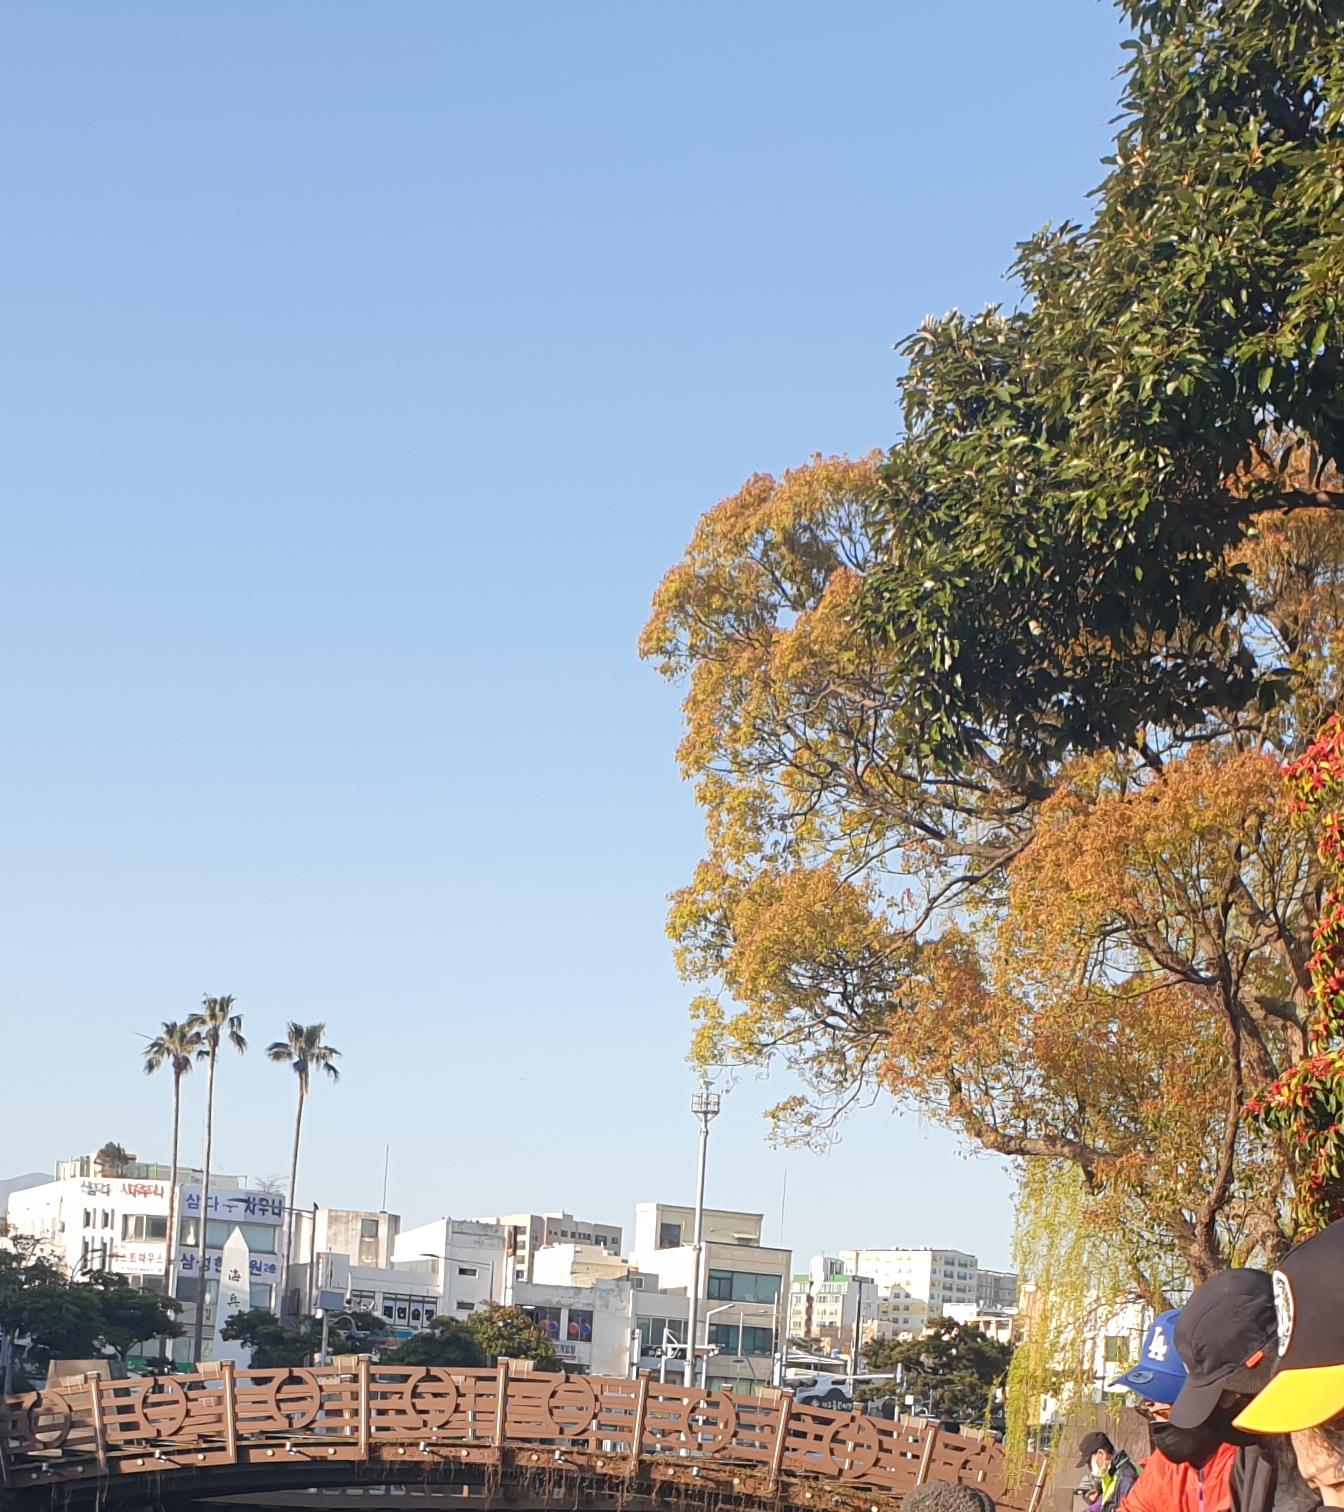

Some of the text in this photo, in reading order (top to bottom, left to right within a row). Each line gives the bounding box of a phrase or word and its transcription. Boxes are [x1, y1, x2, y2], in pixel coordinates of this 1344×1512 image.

[186, 1193, 219, 1212] 삼다
[181, 1253, 262, 1277] 삼성한원
[1147, 1326, 1168, 1362] LA
